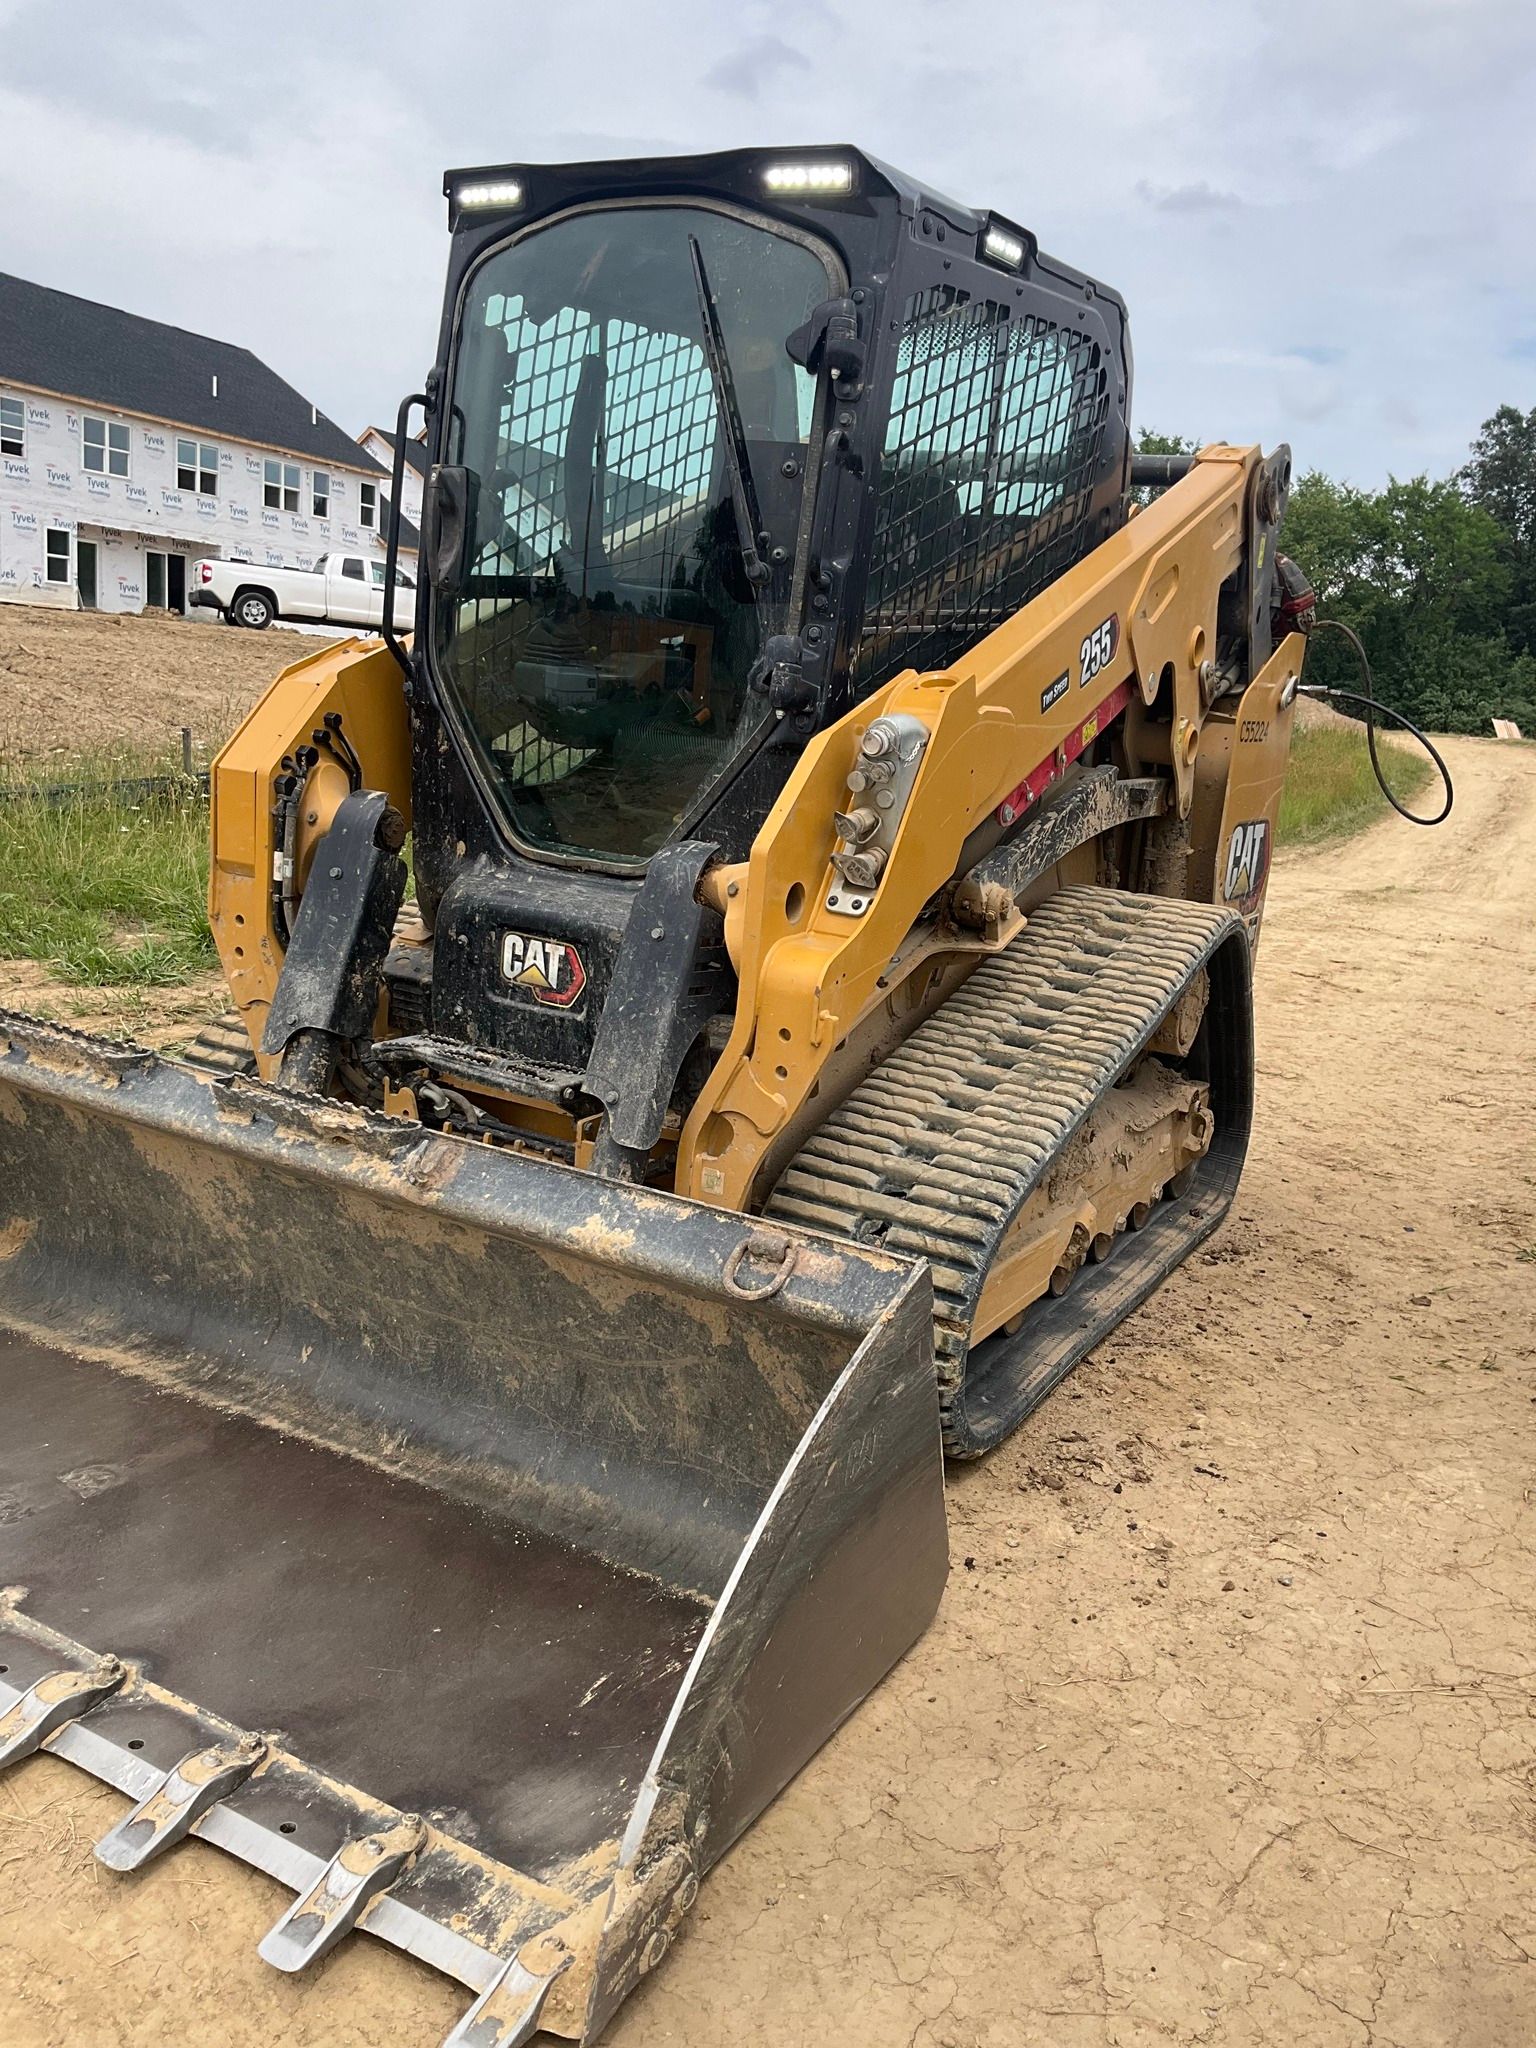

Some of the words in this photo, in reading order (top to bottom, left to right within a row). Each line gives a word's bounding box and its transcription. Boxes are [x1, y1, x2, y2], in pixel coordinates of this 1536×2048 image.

[28, 405, 50, 420] yvek
[143, 433, 165, 446] Tyvek
[4, 460, 30, 474] Tyvek
[46, 468, 71, 482] Tyvek
[87, 476, 110, 489] Tyvek
[125, 484, 147, 497] Tyvek
[161, 491, 183, 504] Tyvek
[196, 498, 217, 510] Tyvek
[11, 511, 37, 524] Tyvek
[229, 505, 249, 517] Tyvek
[261, 511, 279, 523] Tyvek
[291, 518, 309, 529] Tyvek
[101, 526, 122, 537] Tyvek
[341, 528, 358, 538] Tyvek
[137, 532, 158, 545] Tyvek
[171, 538, 193, 549] Tyvek
[234, 546, 253, 557] Tyvek
[266, 551, 284, 562] Tyvek
[296, 556, 313, 566] Tyvek
[118, 582, 140, 595] Tyvek
[1080, 619, 1112, 685] 255
[1239, 720, 1270, 742] C55224
[1225, 823, 1265, 900] CAT
[503, 934, 565, 990] CAT
